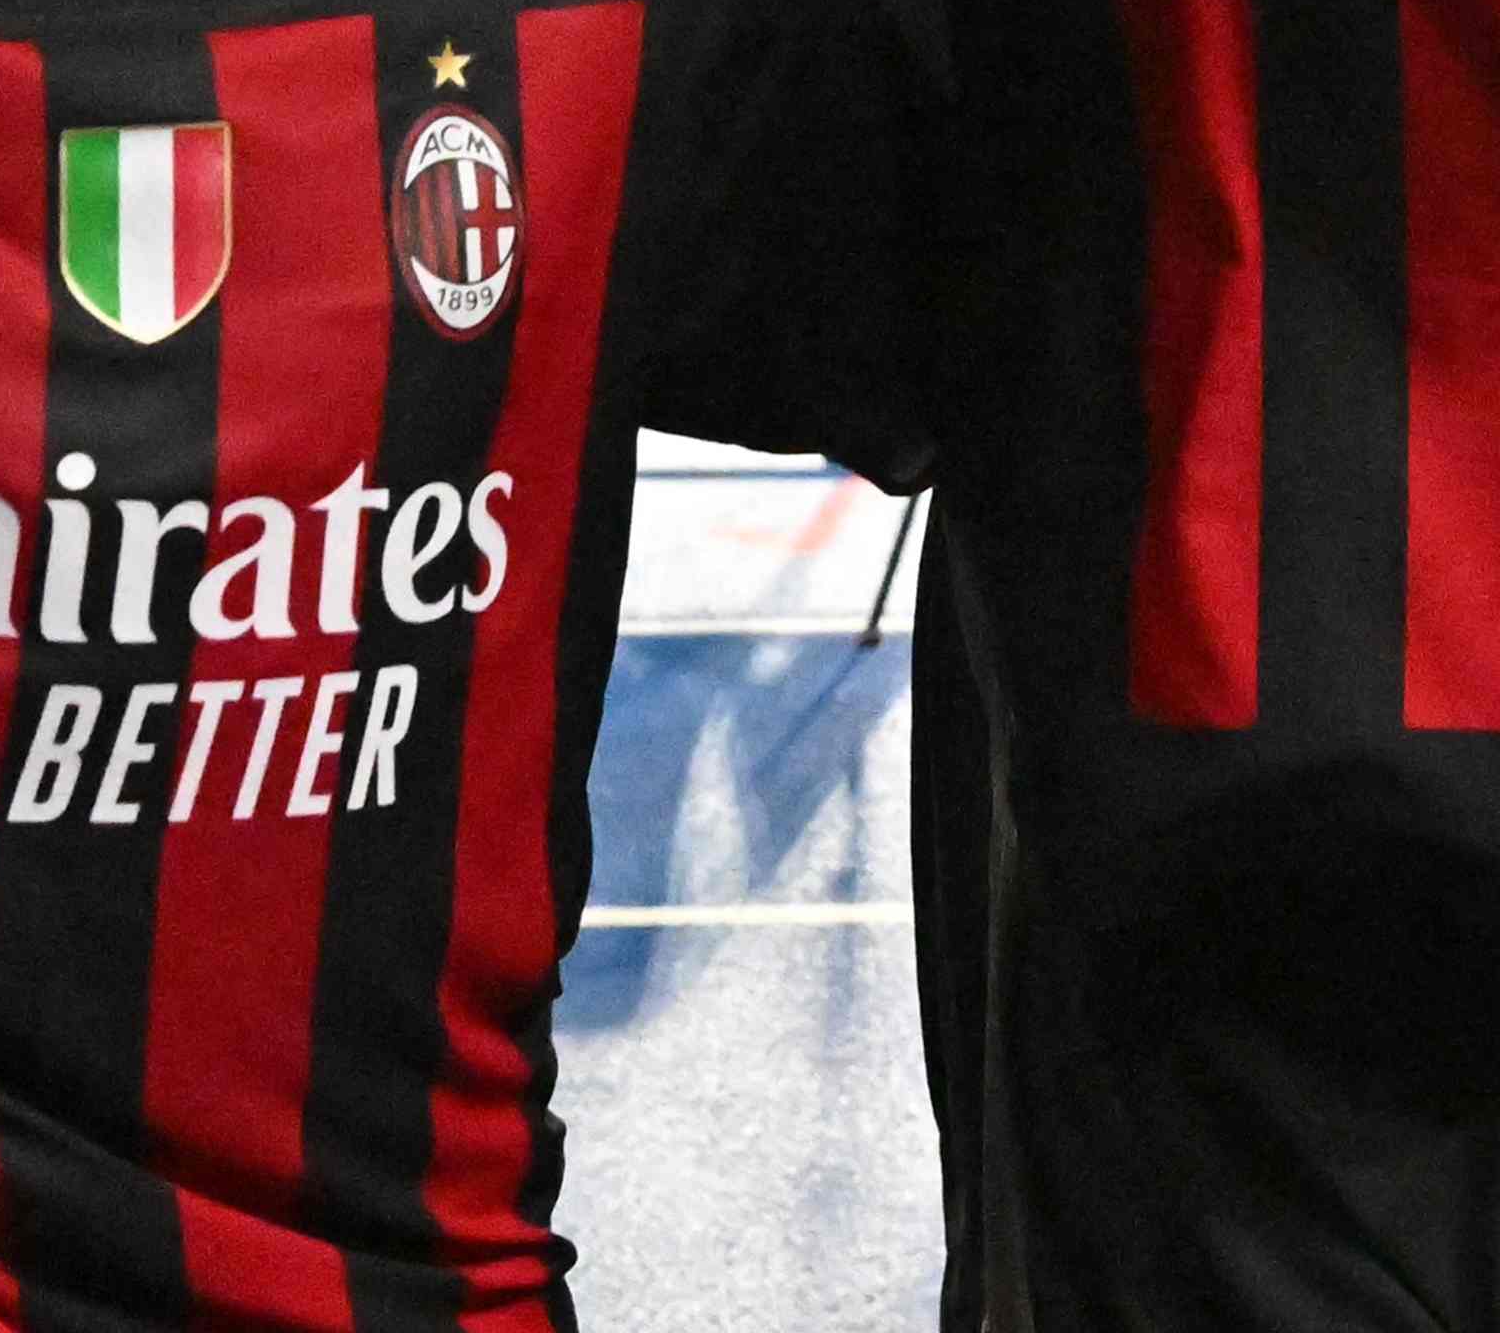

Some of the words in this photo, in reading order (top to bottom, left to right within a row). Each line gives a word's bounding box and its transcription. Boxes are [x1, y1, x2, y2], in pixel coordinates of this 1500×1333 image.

[419, 123, 494, 164] ACM
[437, 284, 495, 312] 1899
[6, 664, 419, 824] BETTER
